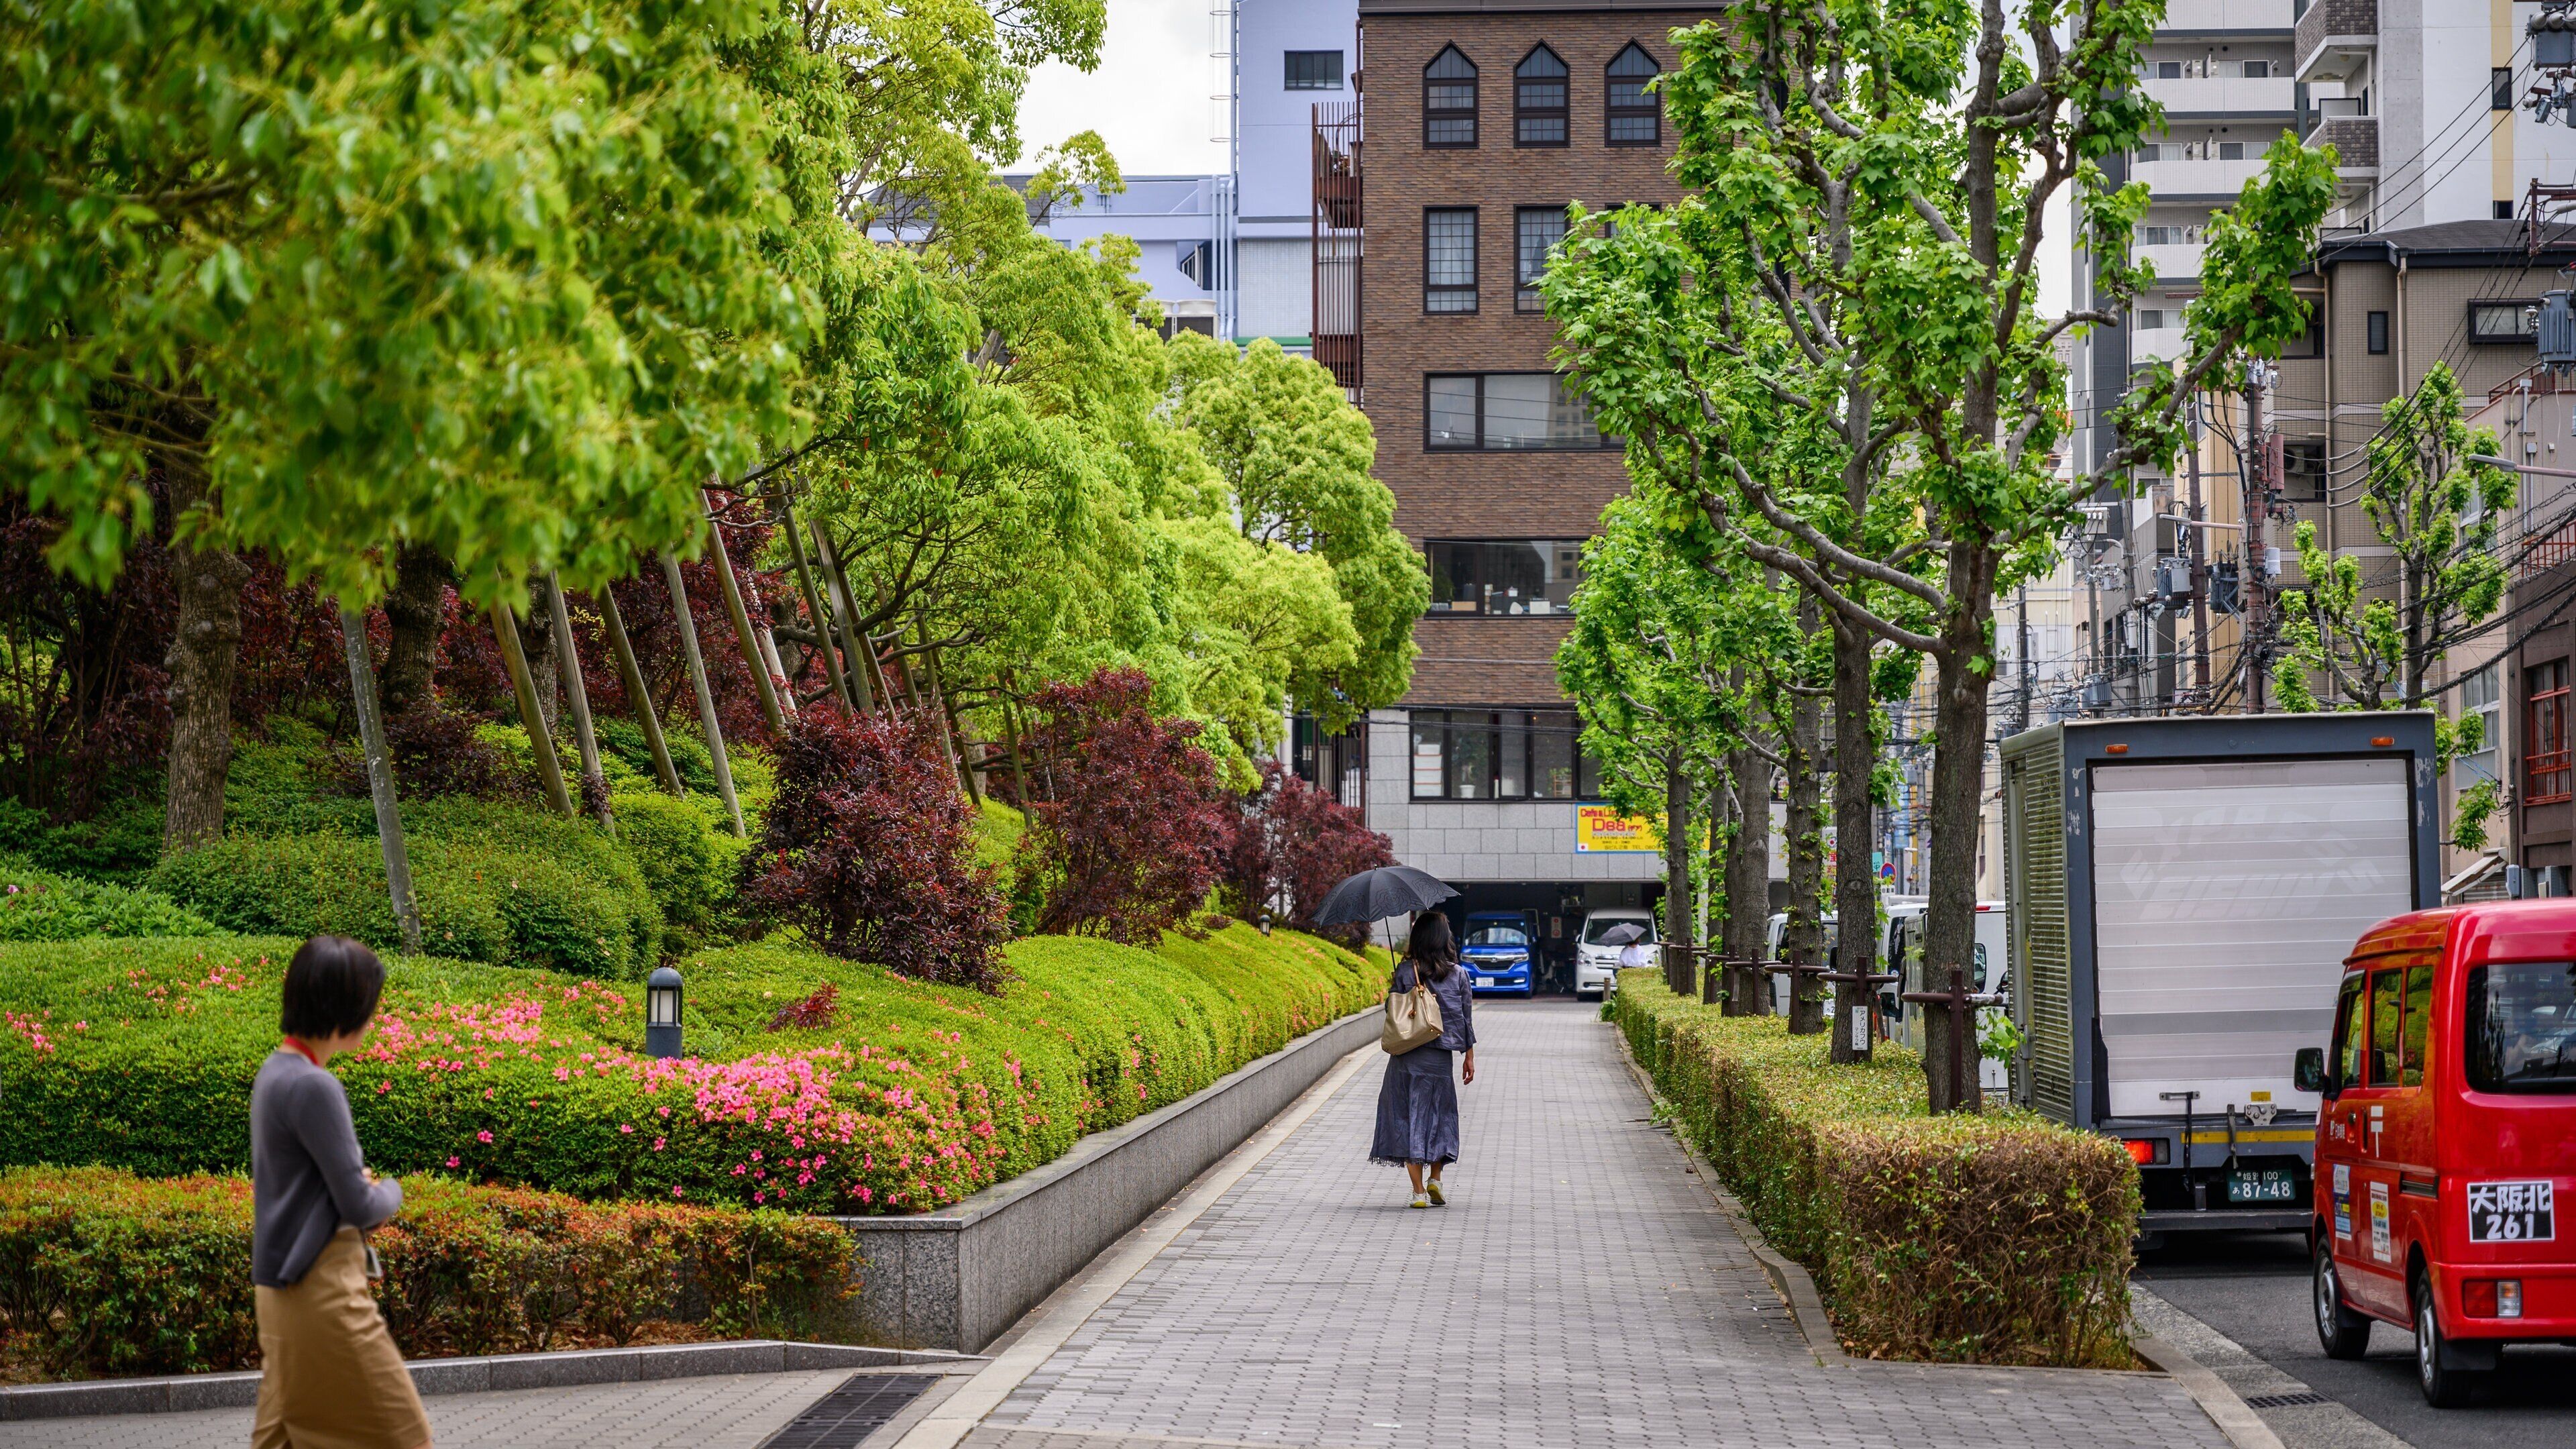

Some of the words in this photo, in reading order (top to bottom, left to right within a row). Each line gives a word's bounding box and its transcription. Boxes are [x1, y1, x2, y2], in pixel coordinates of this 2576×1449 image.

[2263, 1171, 2278, 1180] 100
[2232, 1186, 2240, 1195] あ
[2243, 1181, 2290, 1198] 87-48
[2470, 1185, 2551, 1213] 大阪北
[2487, 1214, 2534, 1239] 261
